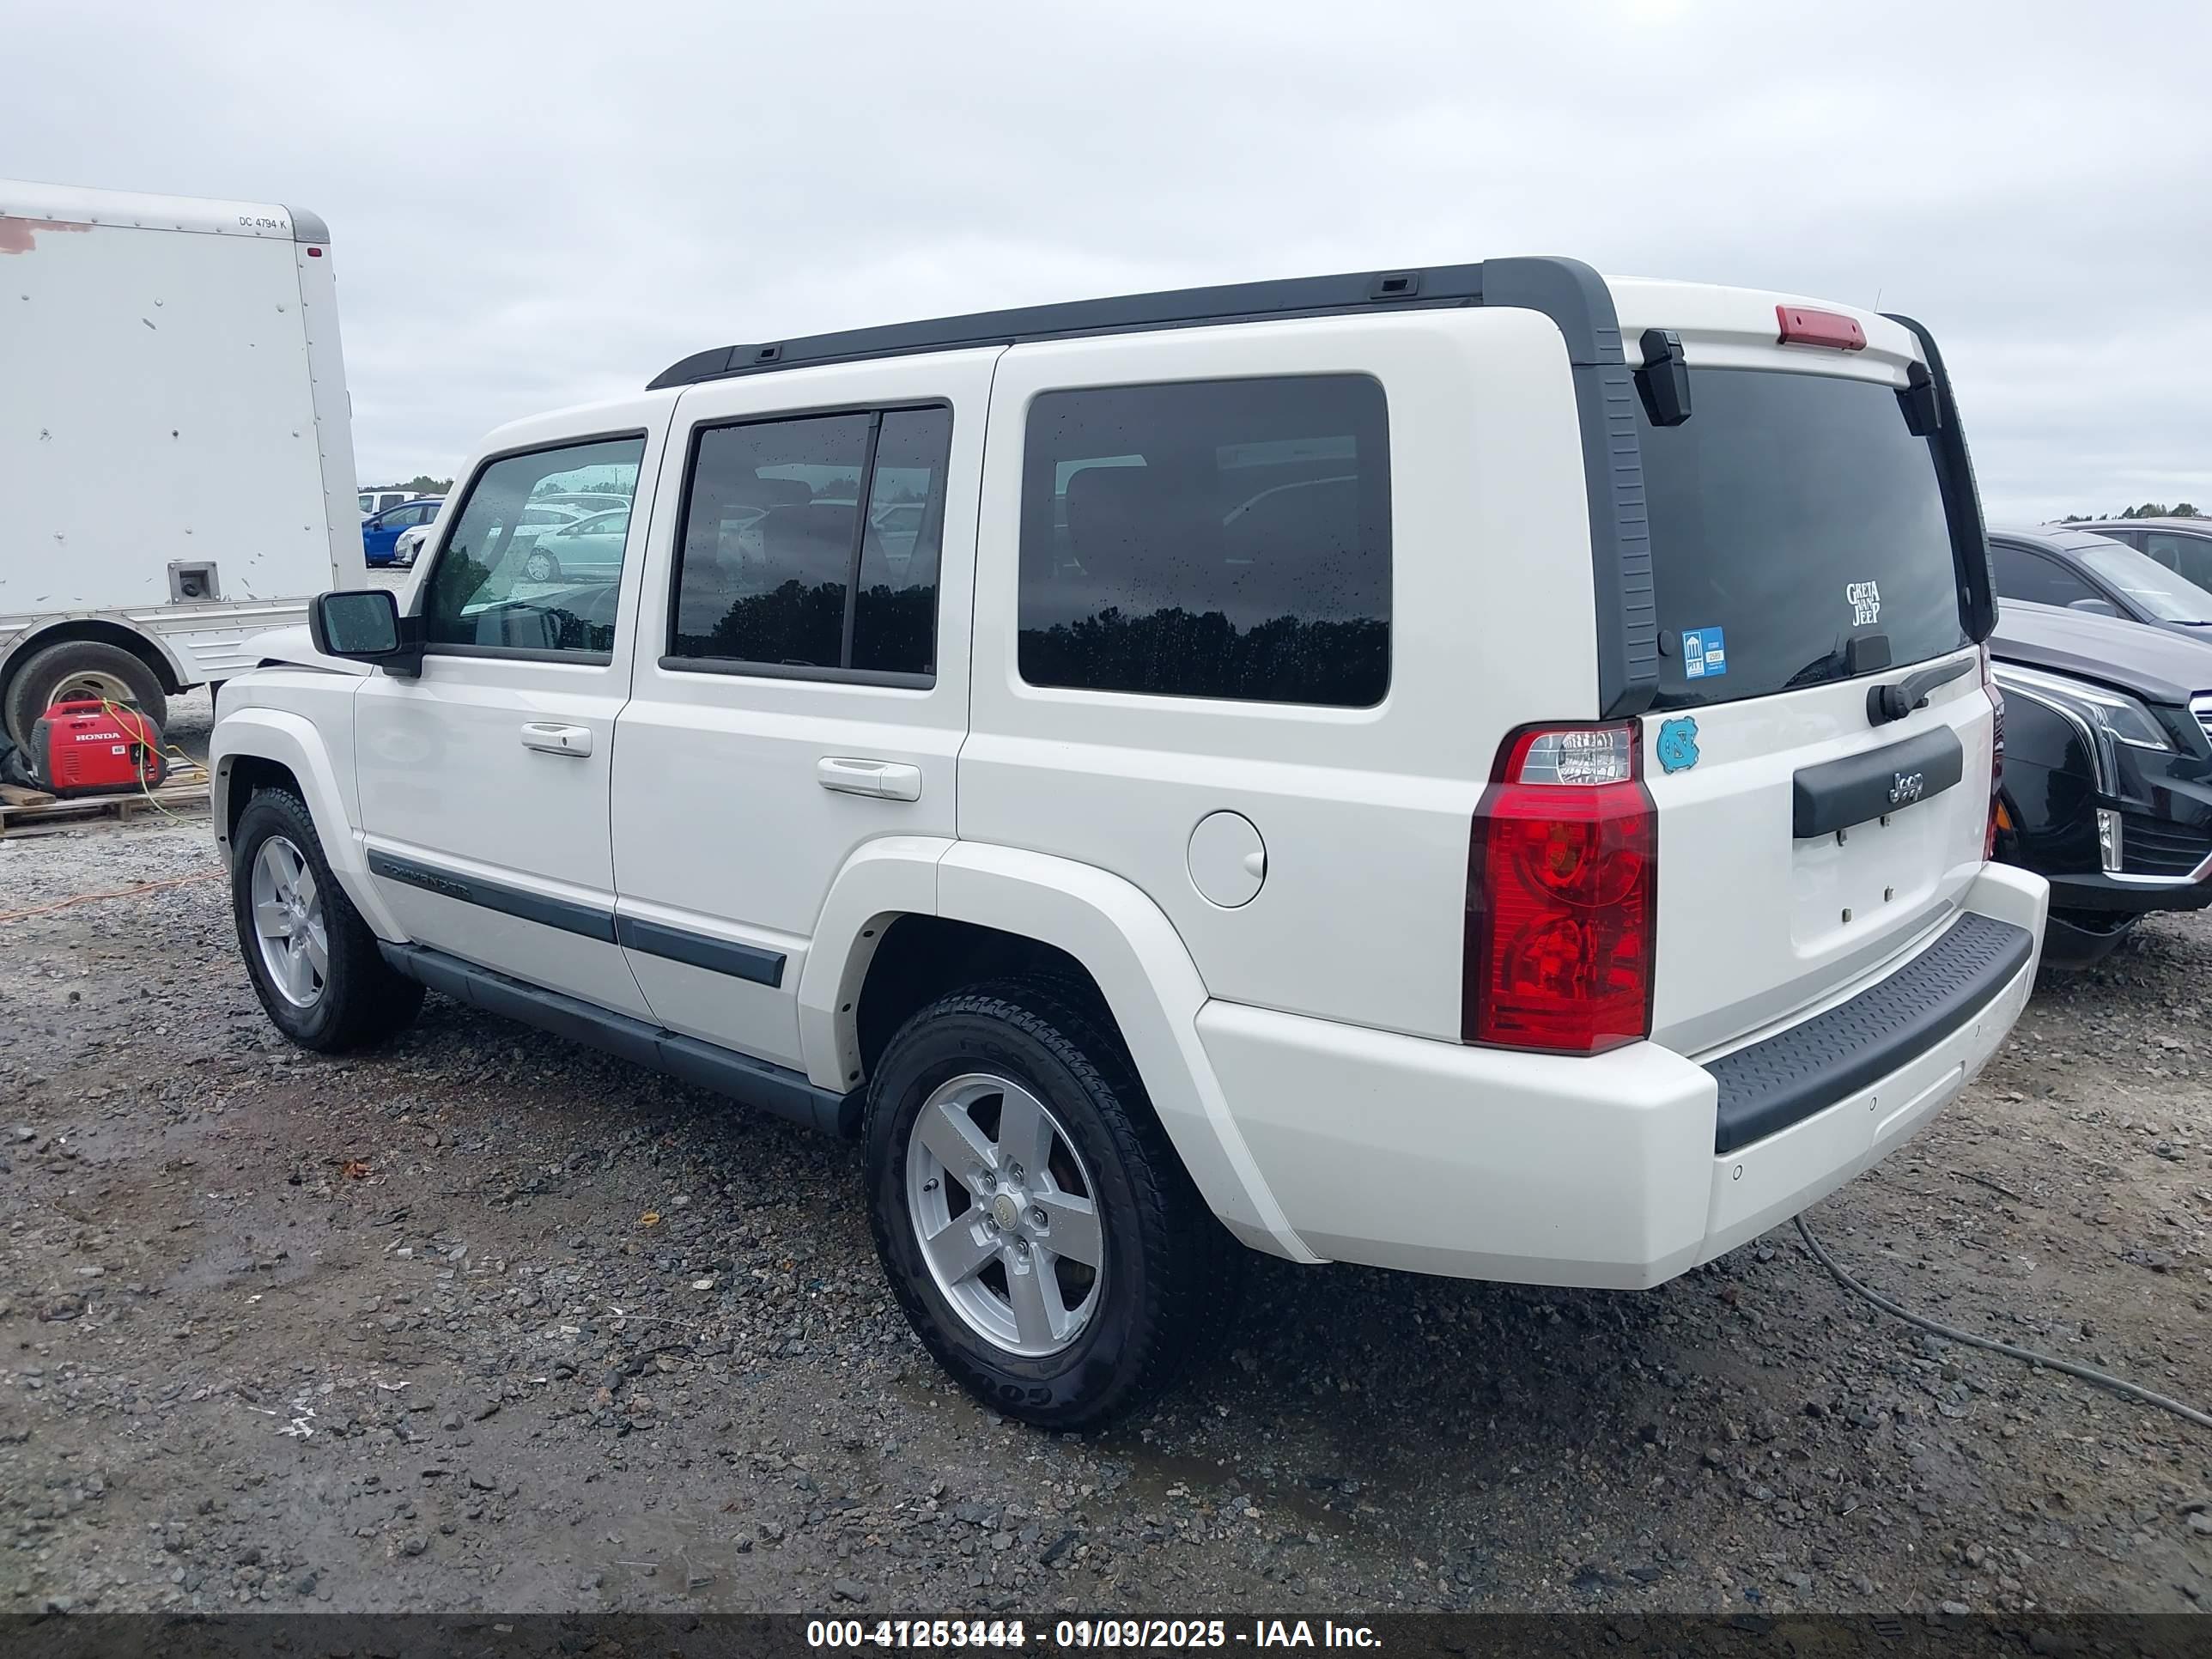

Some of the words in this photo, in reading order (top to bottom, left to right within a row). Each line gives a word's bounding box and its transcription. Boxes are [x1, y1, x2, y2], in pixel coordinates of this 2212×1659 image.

[240, 216, 252, 227] DC
[256, 218, 276, 228] 4794
[280, 220, 287, 229] K
[1846, 580, 1880, 605] GRETA
[1857, 598, 1872, 611] VAN
[1853, 602, 1880, 626] JEEP
[1687, 660, 1703, 671] PITT
[76, 732, 121, 741] HONDA
[1889, 773, 1923, 804] Jeep
